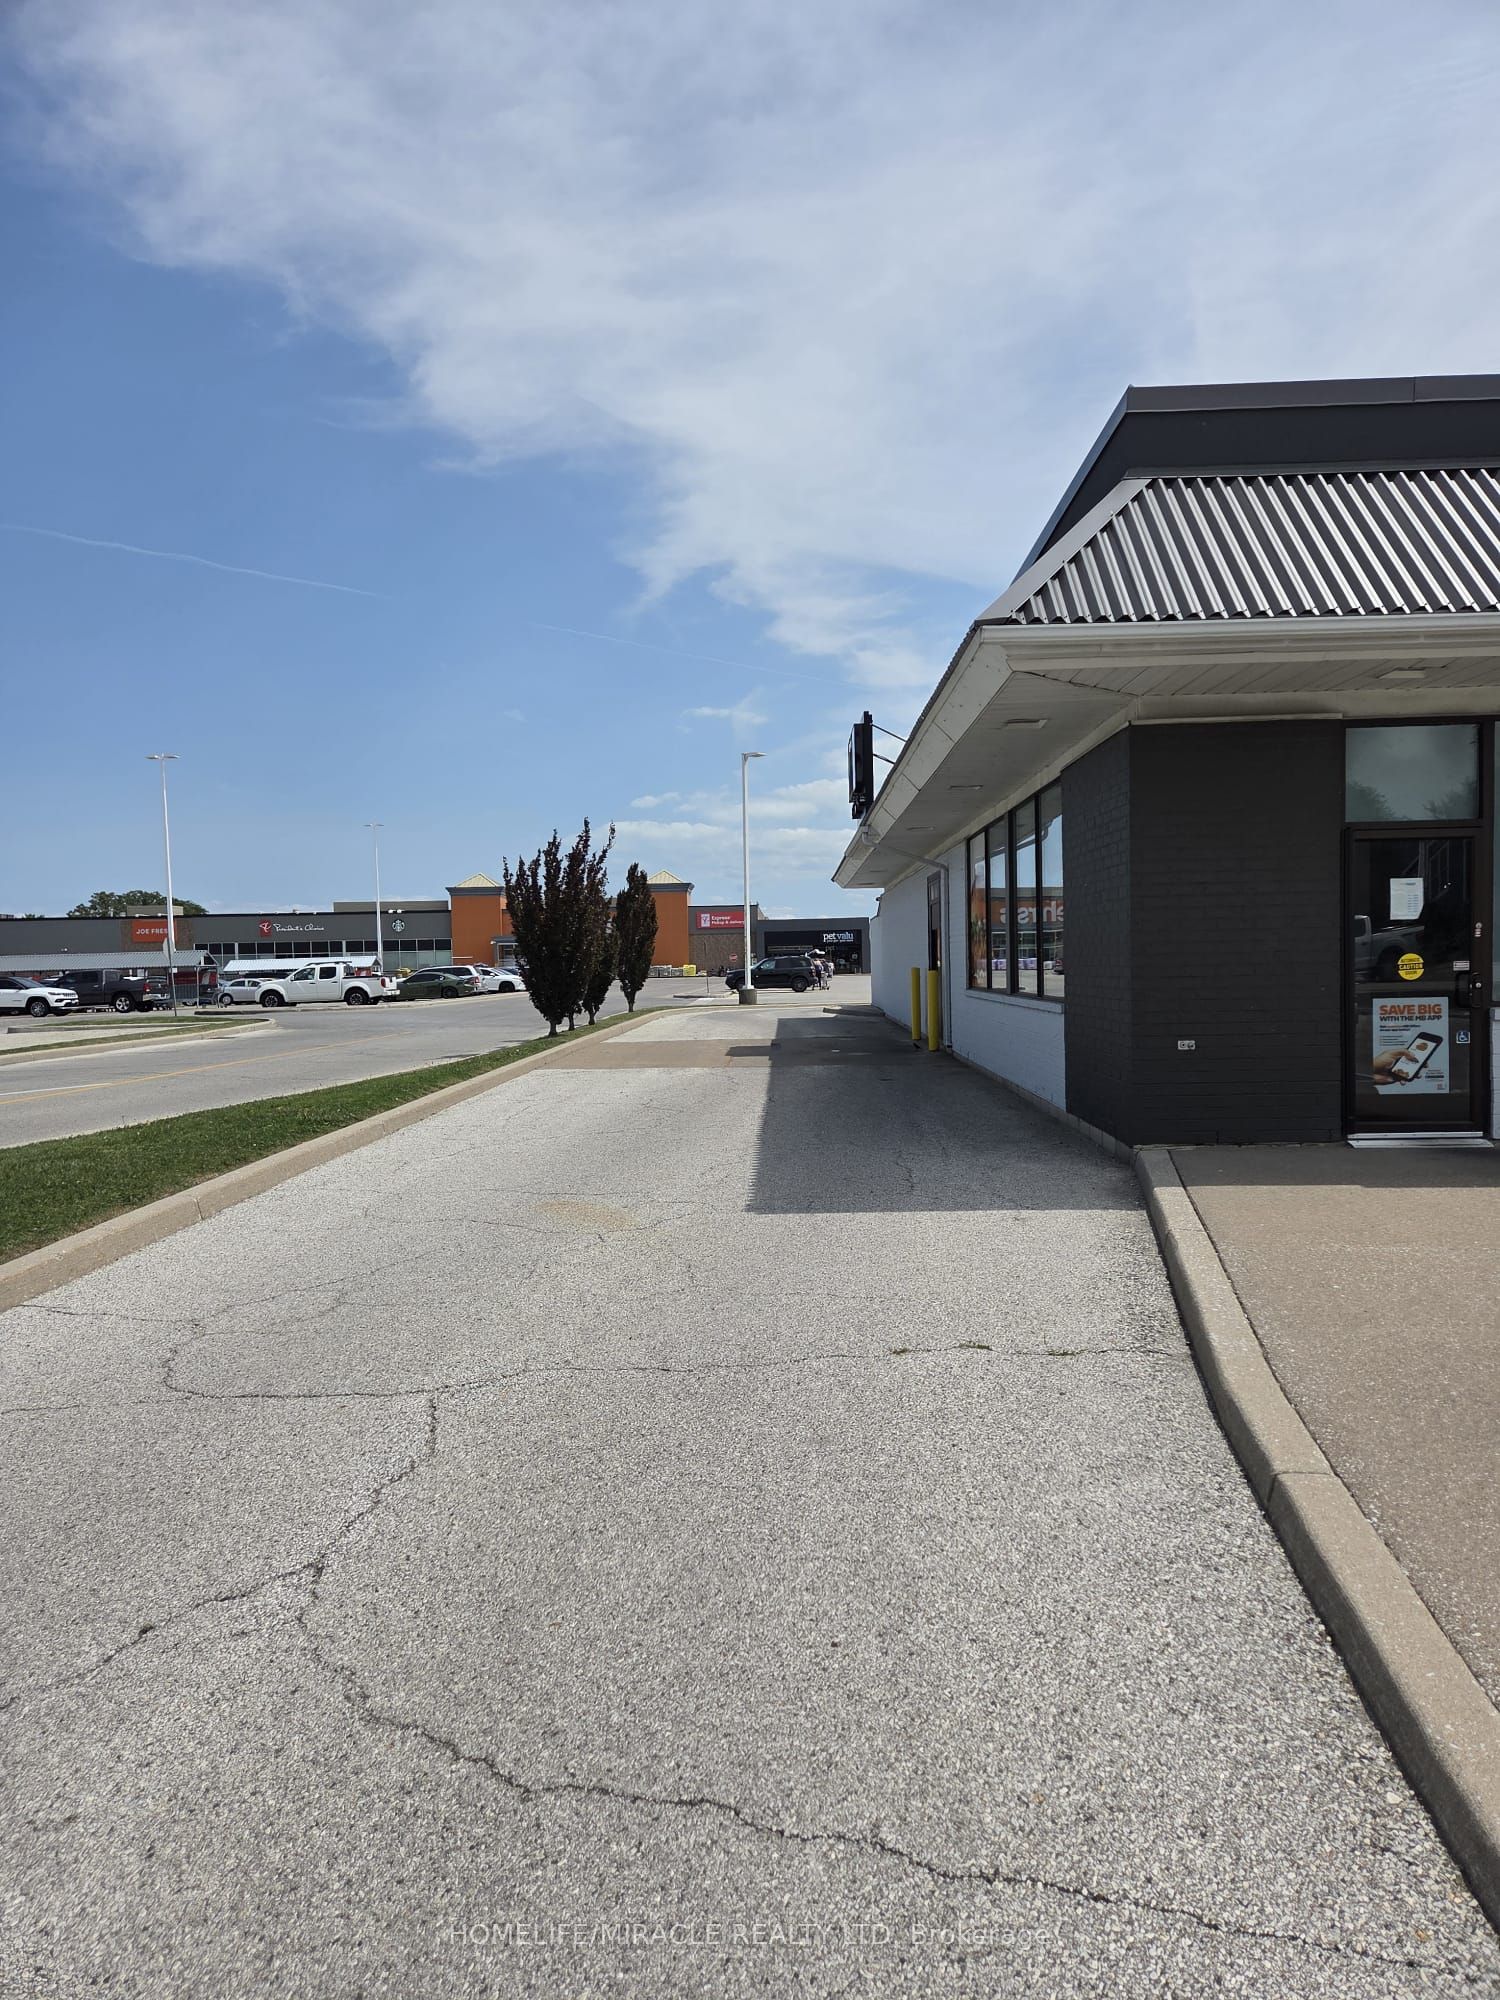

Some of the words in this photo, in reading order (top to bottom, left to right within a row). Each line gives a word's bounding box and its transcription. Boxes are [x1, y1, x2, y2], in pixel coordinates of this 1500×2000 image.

[823, 932, 837, 942] pet
[837, 931, 854, 940] valu
[1379, 1004, 1416, 1015] SAVE
[1418, 1004, 1442, 1014] BIG
